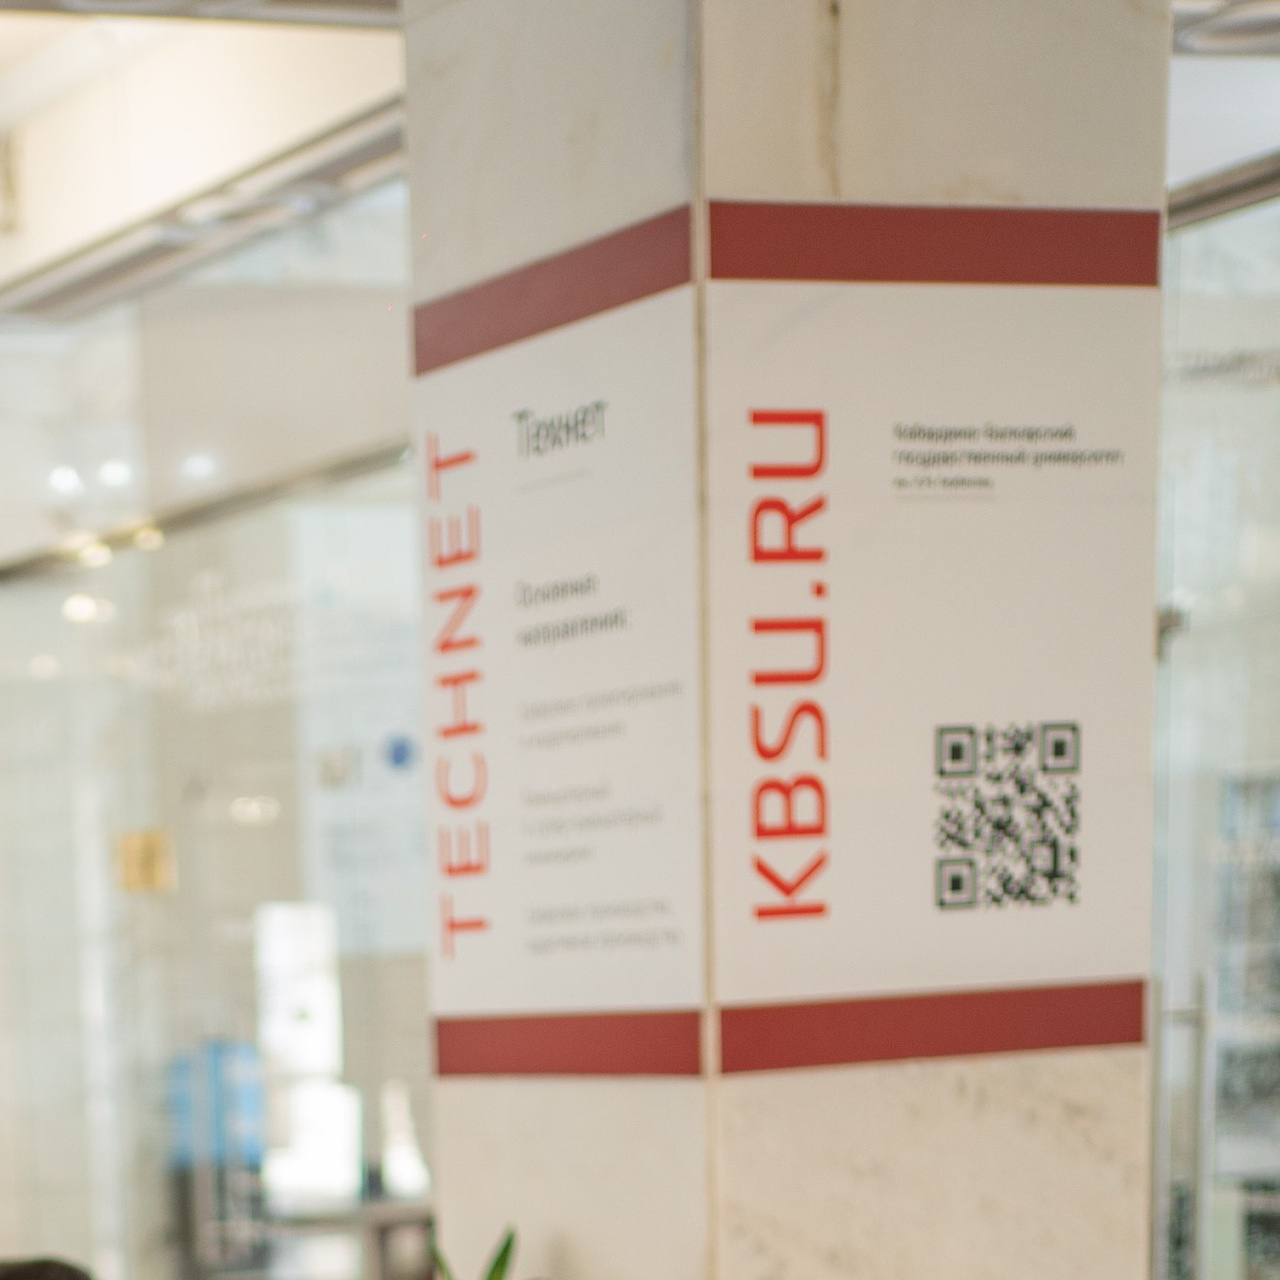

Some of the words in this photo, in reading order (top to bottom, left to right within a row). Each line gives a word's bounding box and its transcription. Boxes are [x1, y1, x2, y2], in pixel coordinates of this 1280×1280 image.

[512, 400, 608, 458] Технет
[748, 408, 829, 922] KBSU.RU
[426, 431, 490, 959] TECHNET
